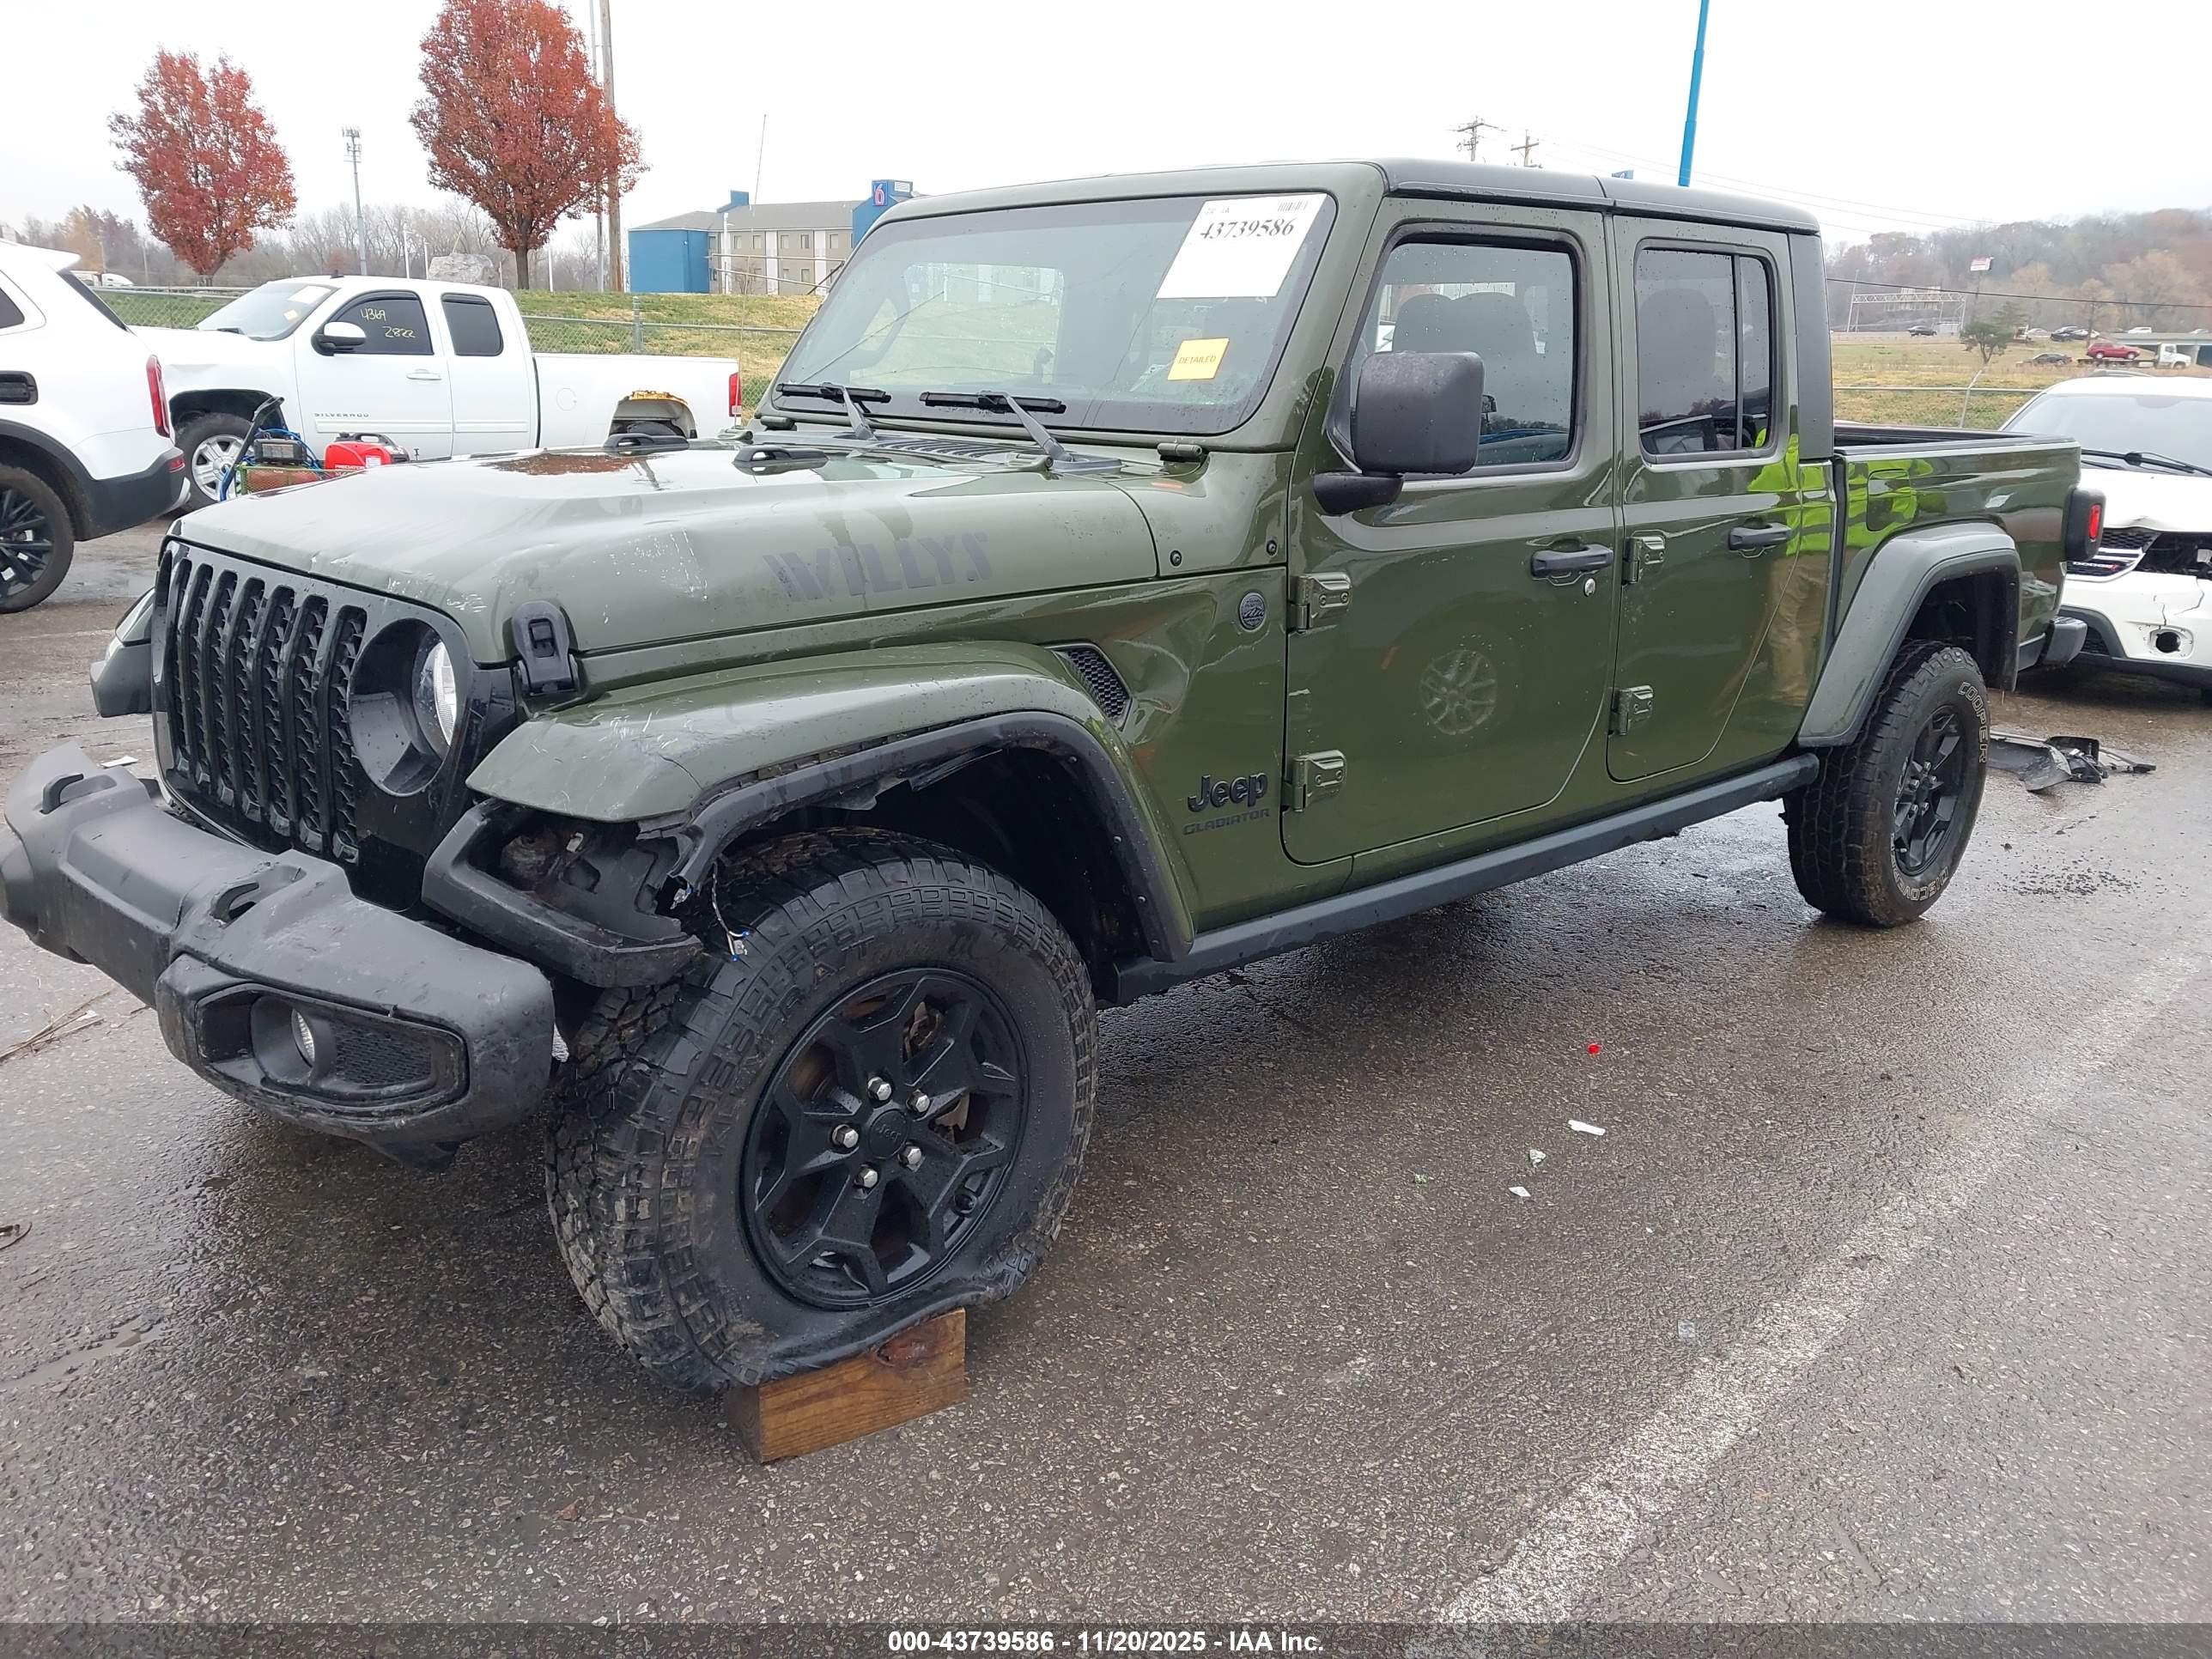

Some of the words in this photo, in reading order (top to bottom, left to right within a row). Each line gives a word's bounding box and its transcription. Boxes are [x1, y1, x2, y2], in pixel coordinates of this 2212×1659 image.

[875, 183, 884, 206] 6
[1200, 217, 1297, 240] 43739586
[360, 307, 387, 322] 4369
[382, 325, 416, 338] 2822
[1177, 354, 1218, 365] DETAILED
[762, 532, 994, 603] WILLYS
[1957, 680, 1990, 764] COOPER
[1188, 771, 1268, 812] Jeep
[1182, 808, 1270, 836] GLADIATOR
